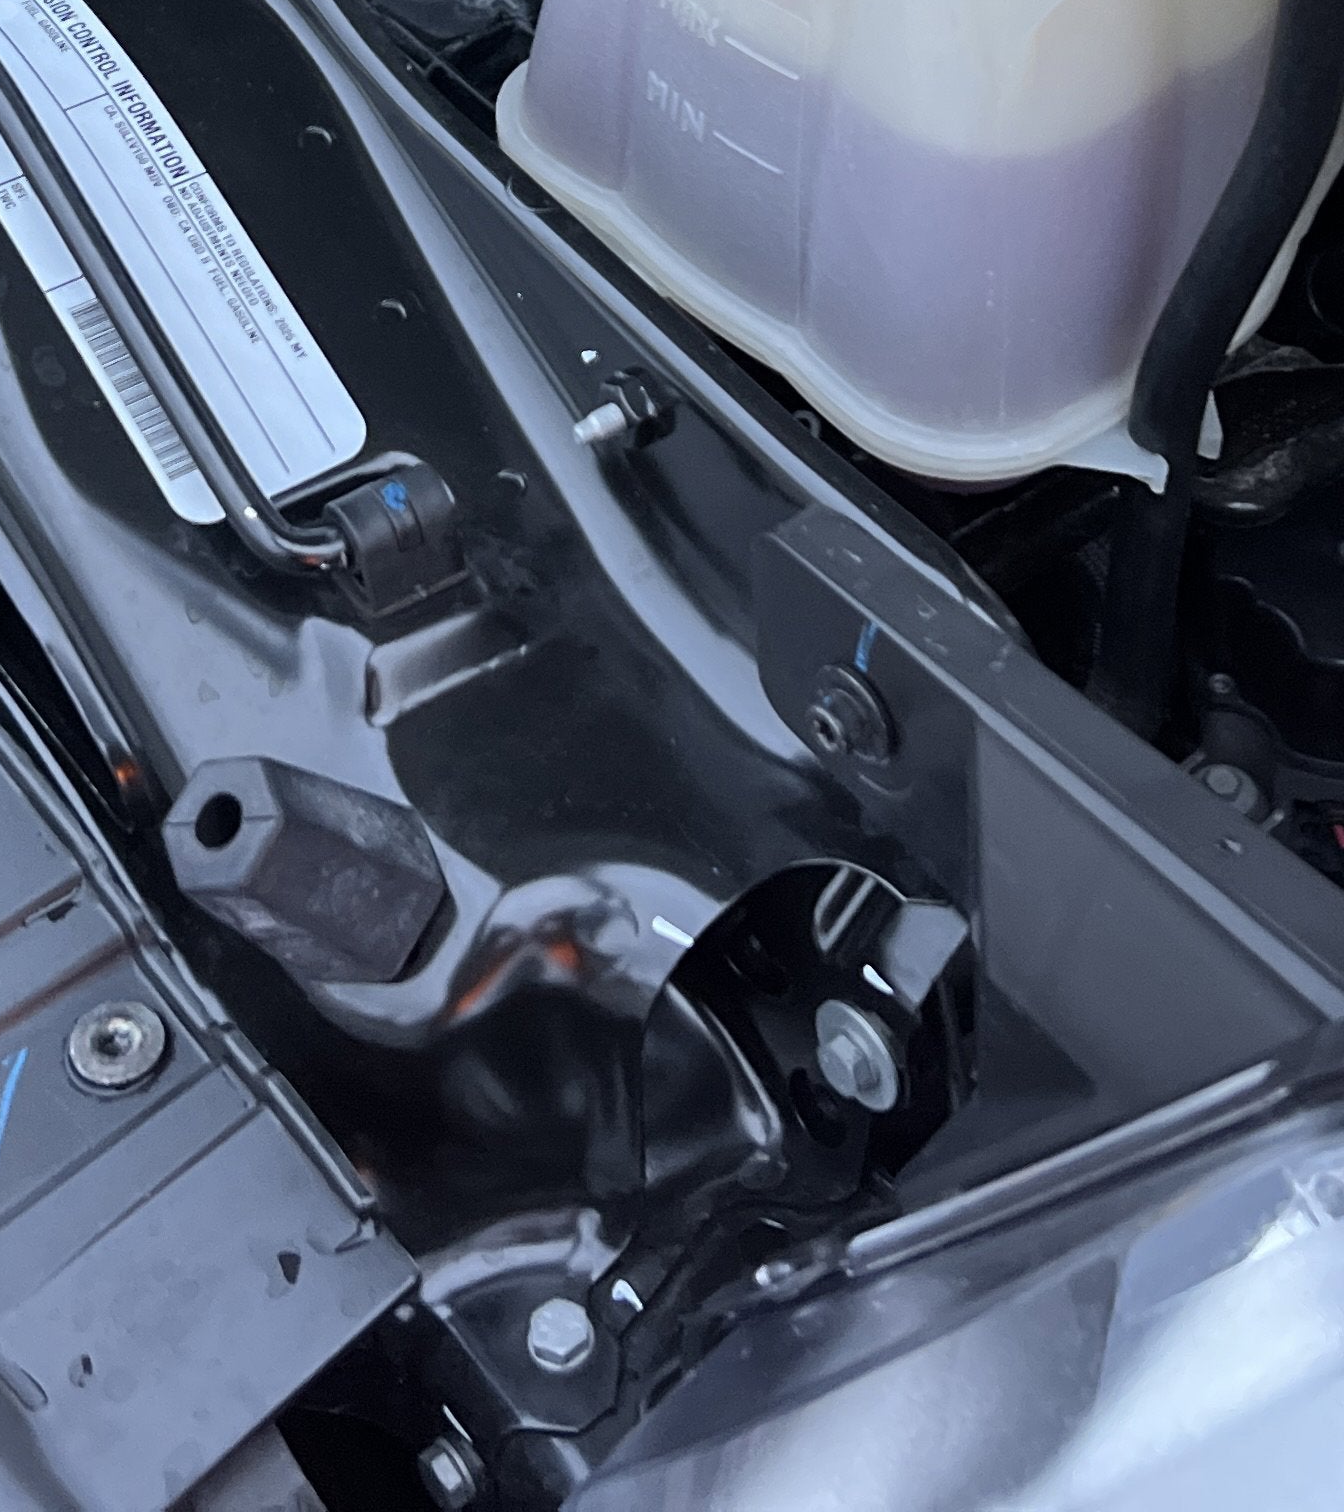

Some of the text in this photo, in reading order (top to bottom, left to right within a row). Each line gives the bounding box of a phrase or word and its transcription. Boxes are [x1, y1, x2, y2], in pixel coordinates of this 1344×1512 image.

[66, 20, 121, 77] CONTROL
[112, 79, 190, 180] INFORMATION
[644, 68, 705, 142] MIN
[177, 185, 261, 307] NO ADJUSTMENTS NEEDED
[177, 218, 193, 233] CA
[186, 233, 207, 255] OBD
[225, 296, 263, 344] GASOLINE
[188, 180, 230, 233] CONFORMS
[221, 233, 238, 248] TO
[289, 341, 308, 358] MY
